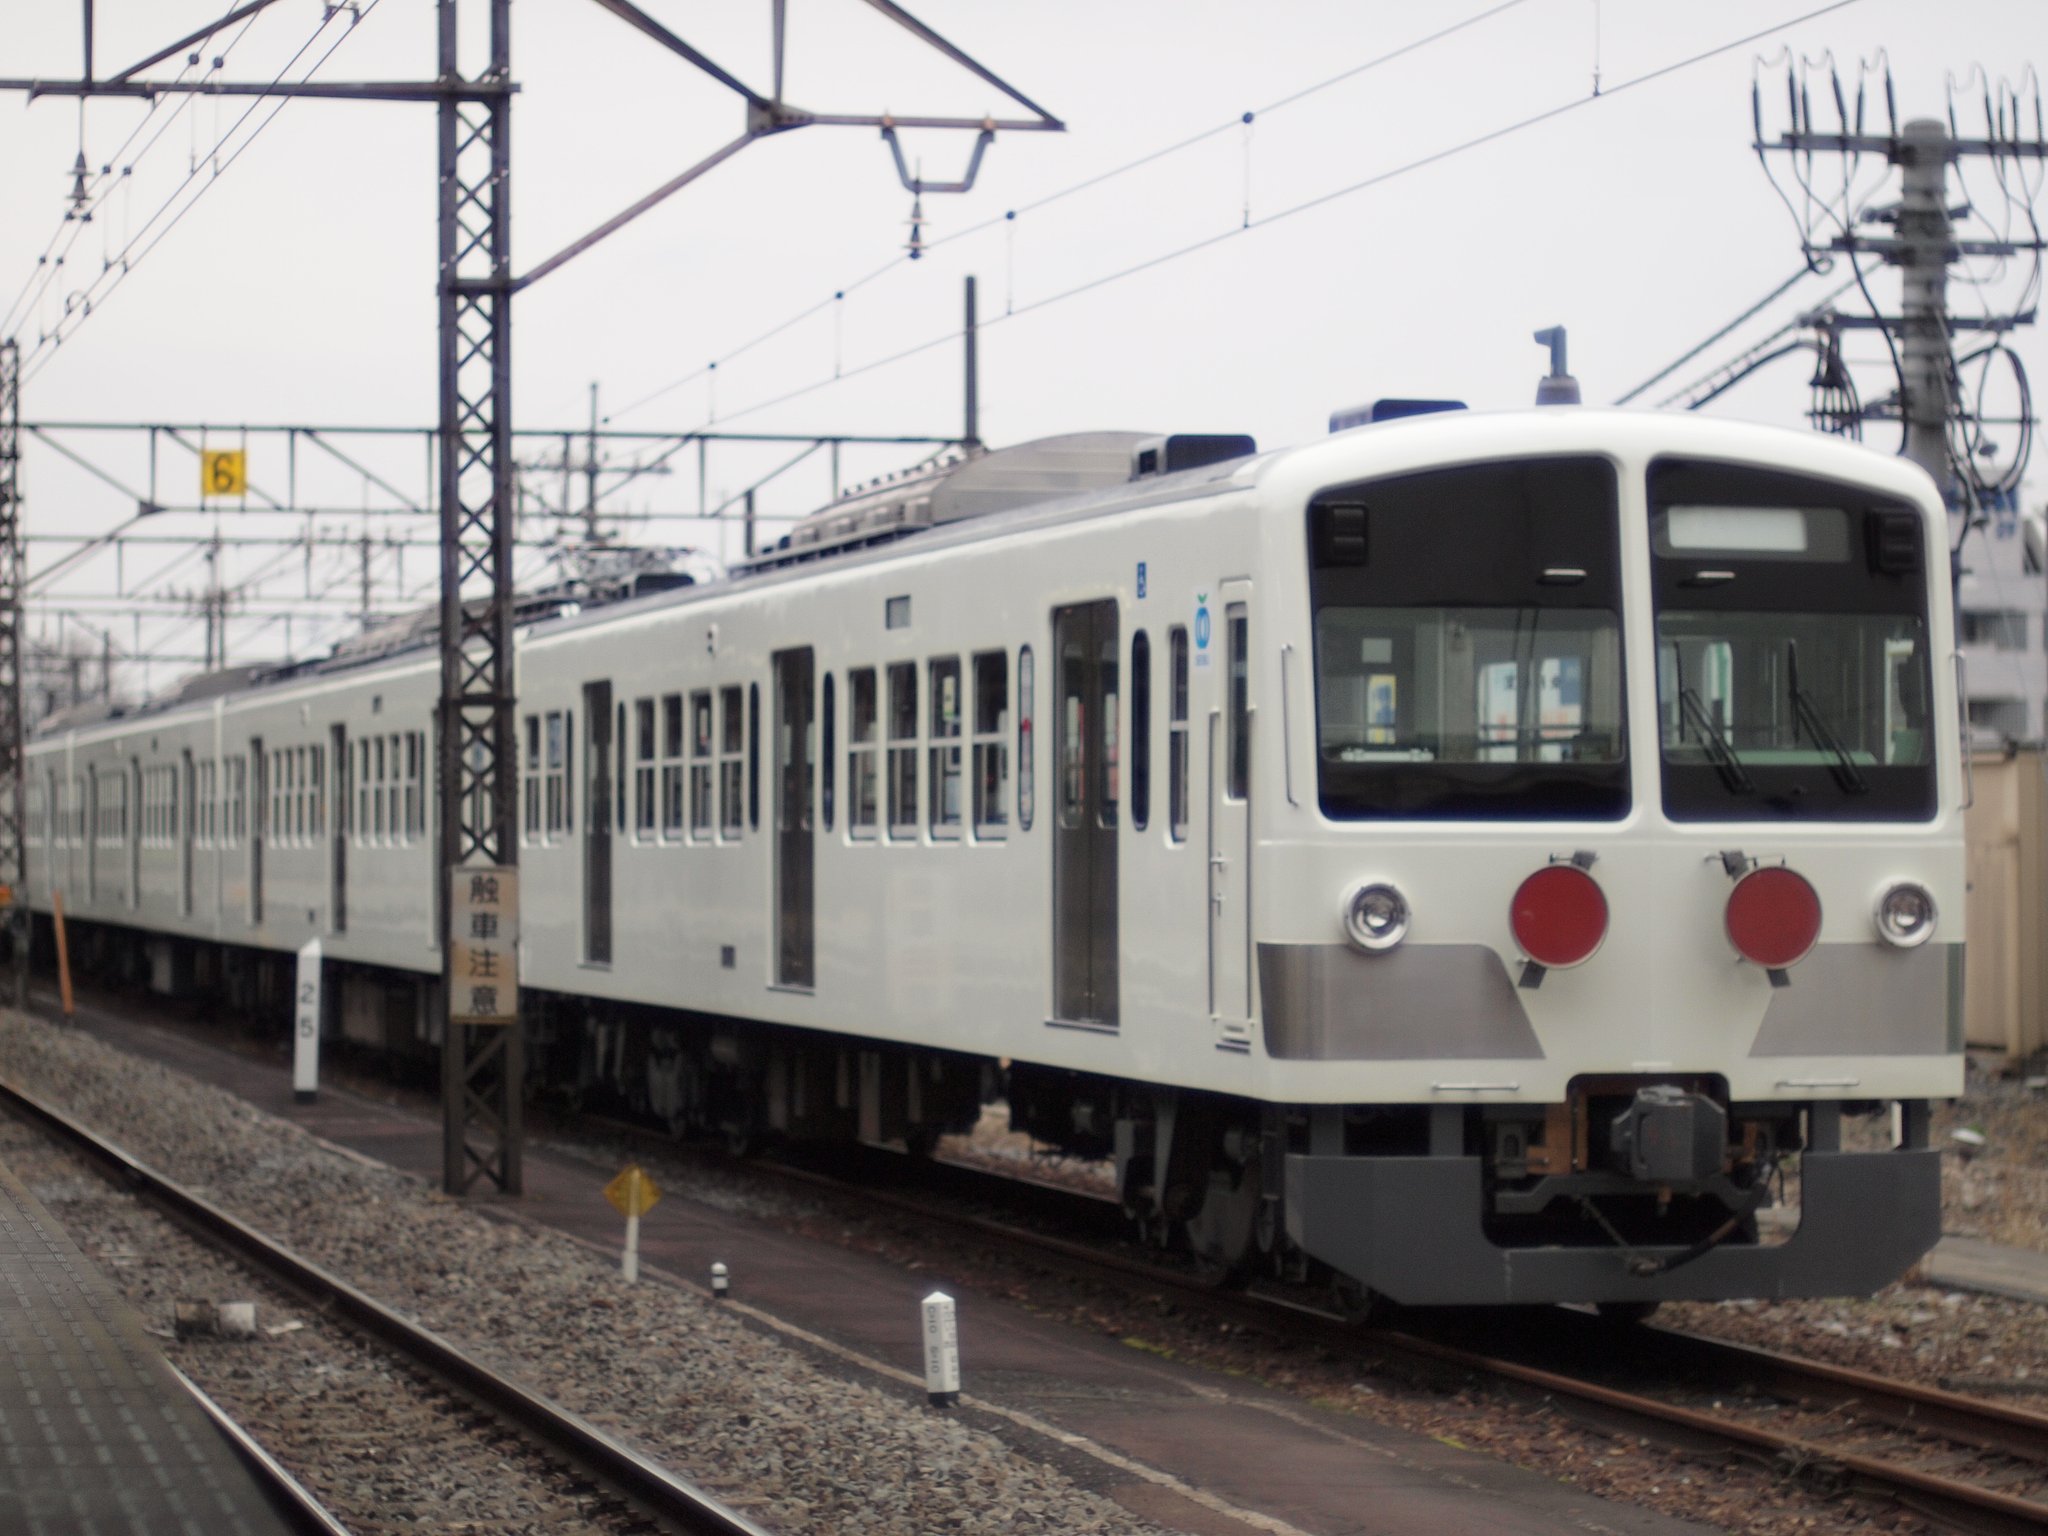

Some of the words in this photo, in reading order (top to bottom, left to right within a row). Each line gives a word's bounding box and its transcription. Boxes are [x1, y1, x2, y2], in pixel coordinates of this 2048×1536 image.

[212, 452, 234, 494] 6
[469, 874, 499, 1016] 触車注意
